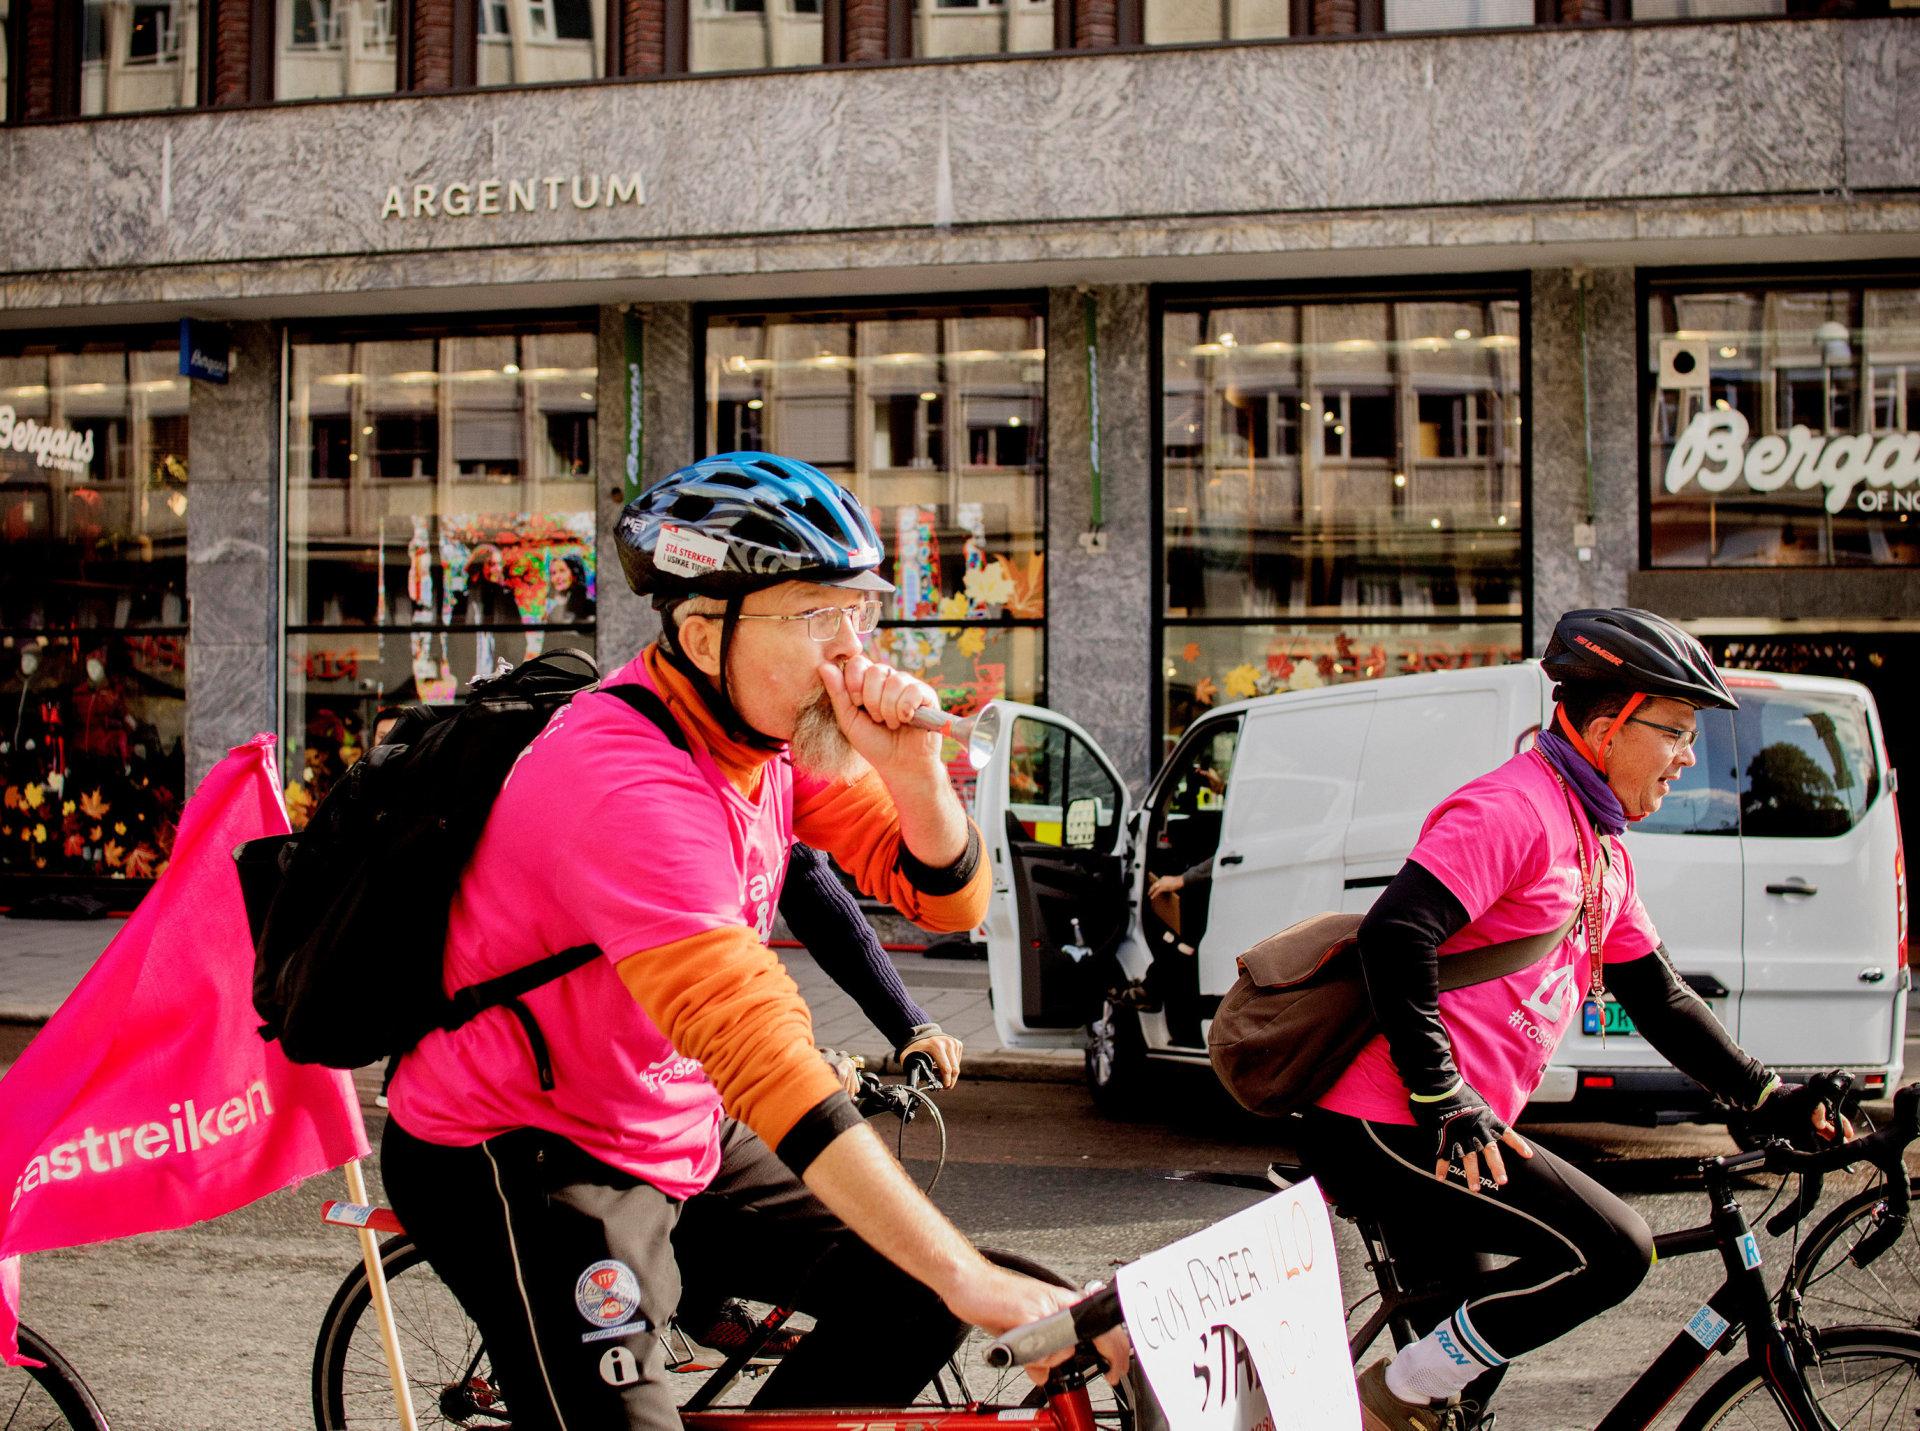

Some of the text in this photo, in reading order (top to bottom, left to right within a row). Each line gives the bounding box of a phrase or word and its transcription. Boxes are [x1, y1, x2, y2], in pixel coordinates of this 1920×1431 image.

[381, 172, 645, 219] ARGENTUM
[1857, 490, 1888, 512] OF
[623, 516, 650, 534] MET
[679, 547, 717, 567] STERKERE
[1585, 884, 1599, 954] BREITLING
[1743, 1236, 1759, 1266] R
[598, 1273, 614, 1285] ITF
[1689, 1305, 1711, 1331] RIDERS
[1695, 1319, 1714, 1340] CLUB
[1702, 1318, 1728, 1348] NORWAY
[1435, 1330, 1472, 1365] RCN
